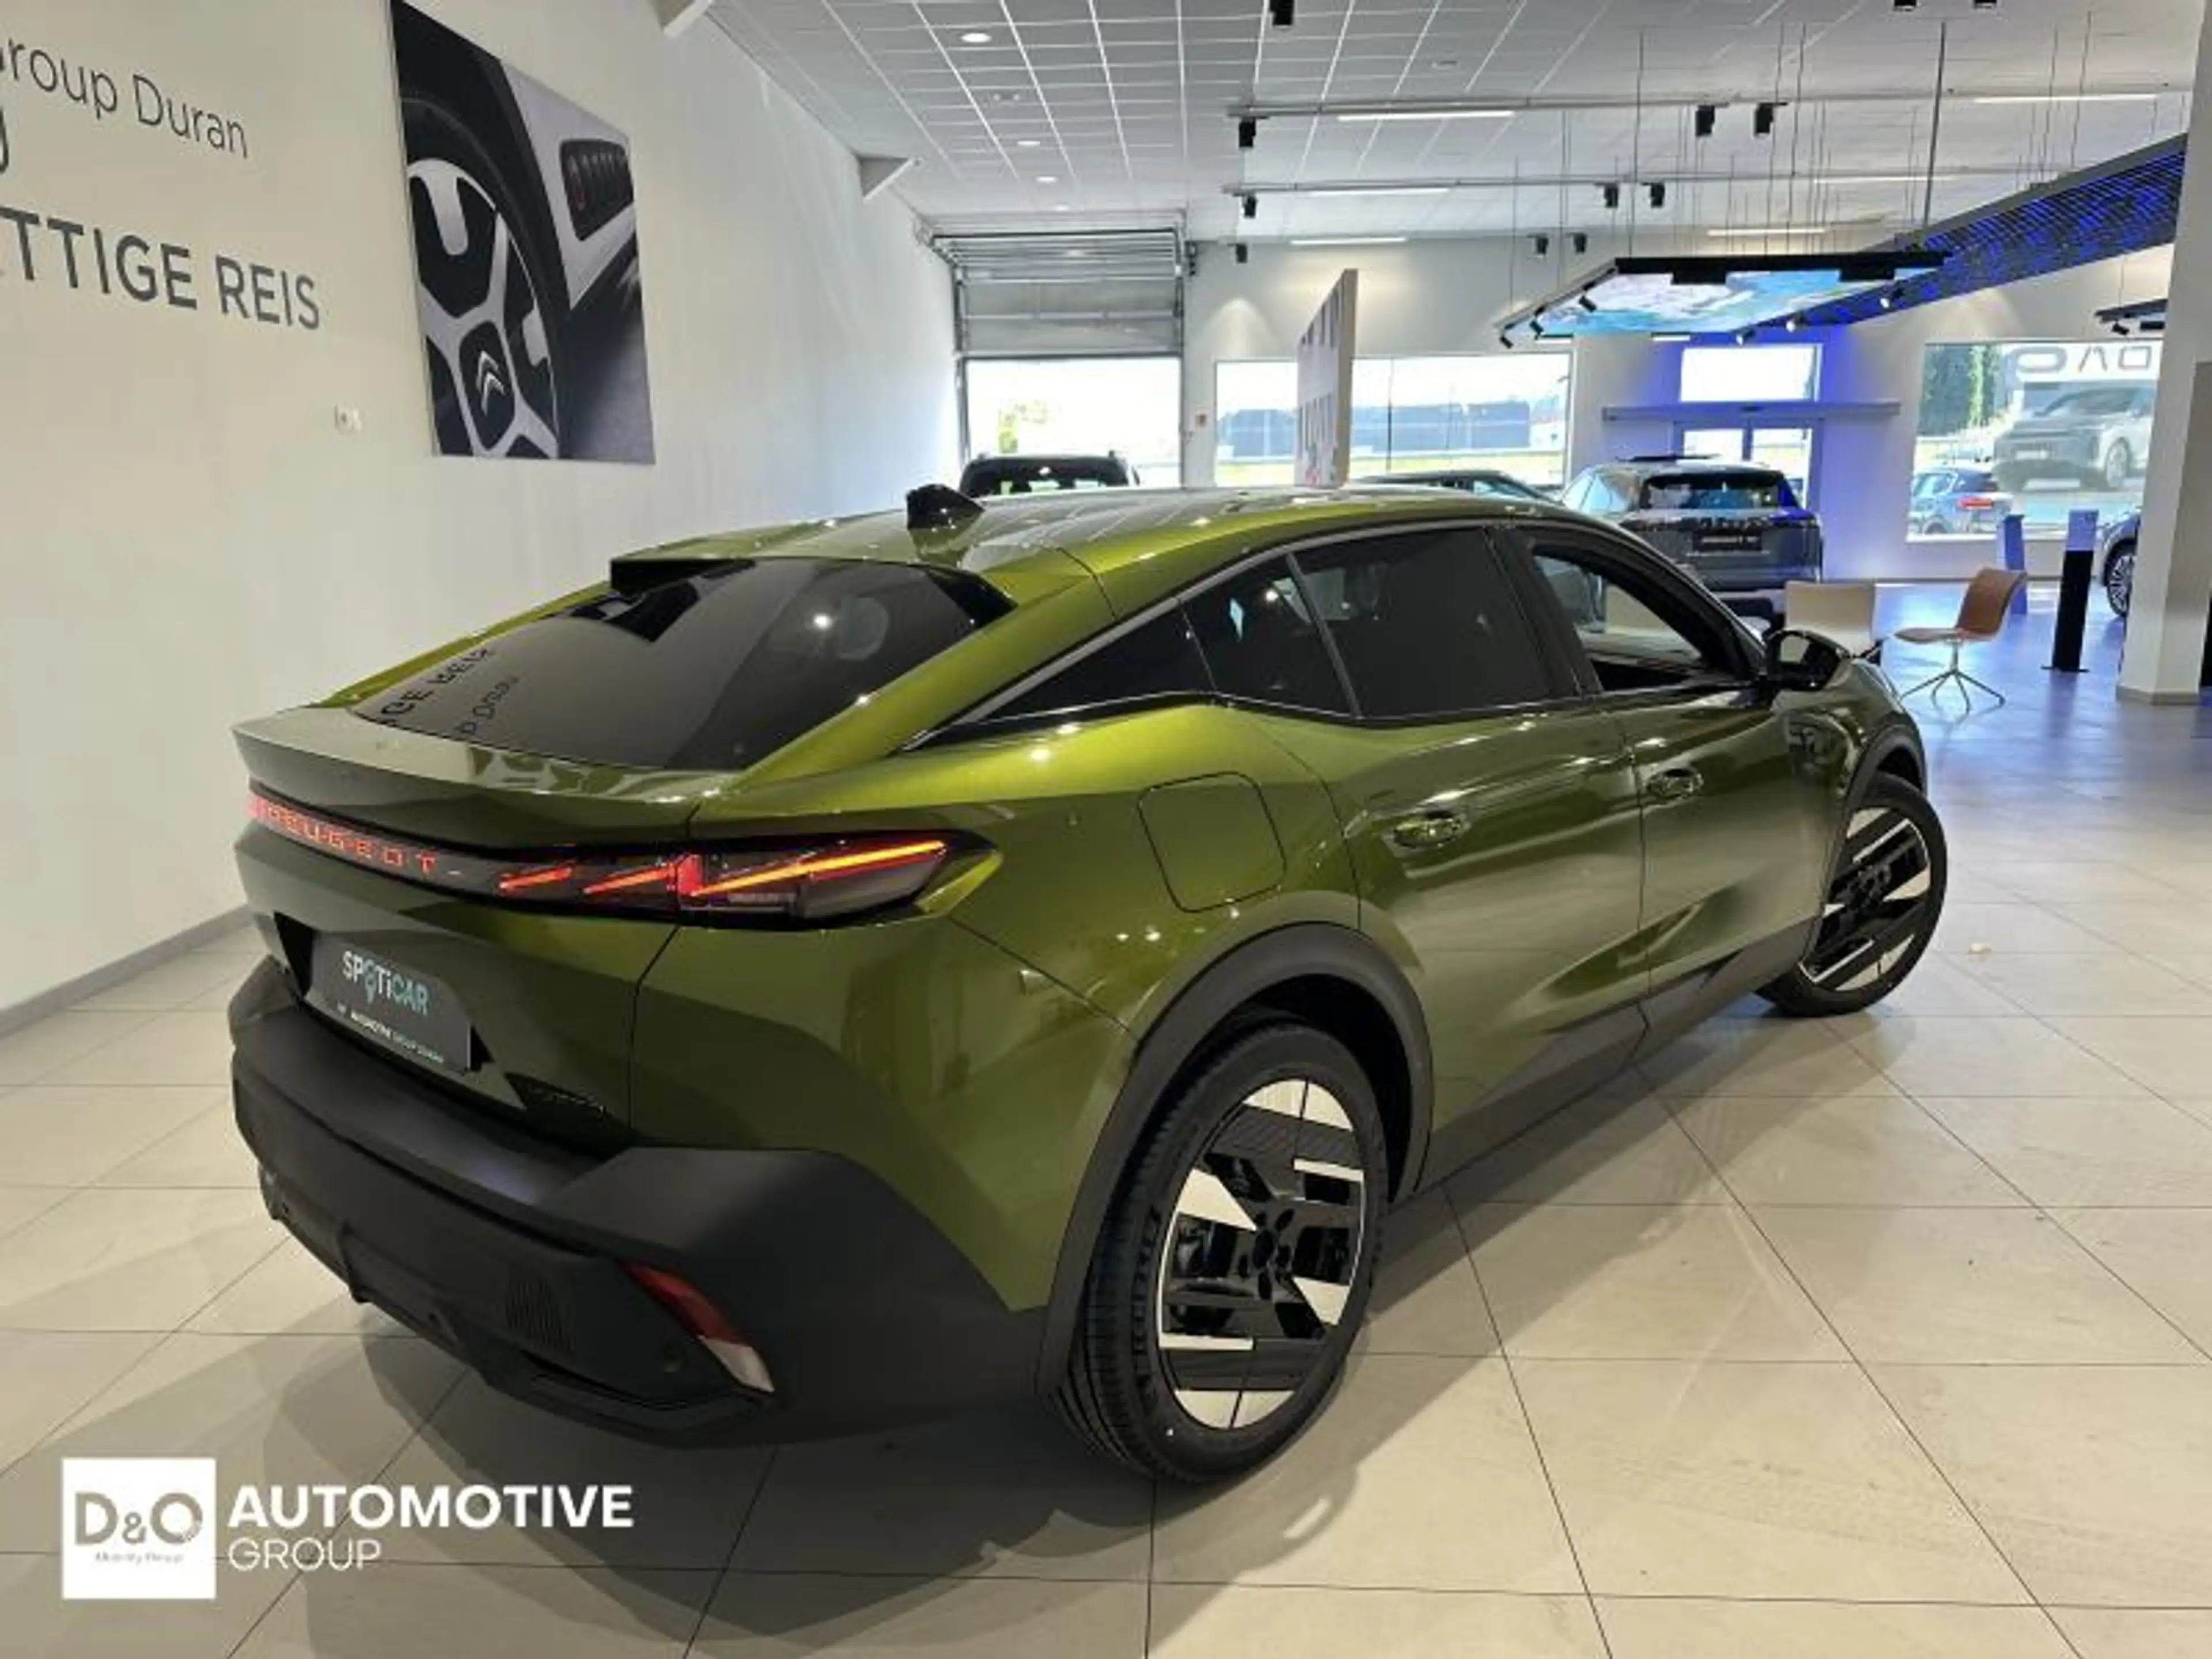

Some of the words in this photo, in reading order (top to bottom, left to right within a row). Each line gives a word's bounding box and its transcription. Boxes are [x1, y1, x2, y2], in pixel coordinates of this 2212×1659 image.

[0, 38, 118, 119] roup
[132, 74, 248, 158] Duran
[0, 206, 198, 310] TTIGE
[215, 254, 320, 330] REIS
[265, 804, 437, 877] PEUGEOT
